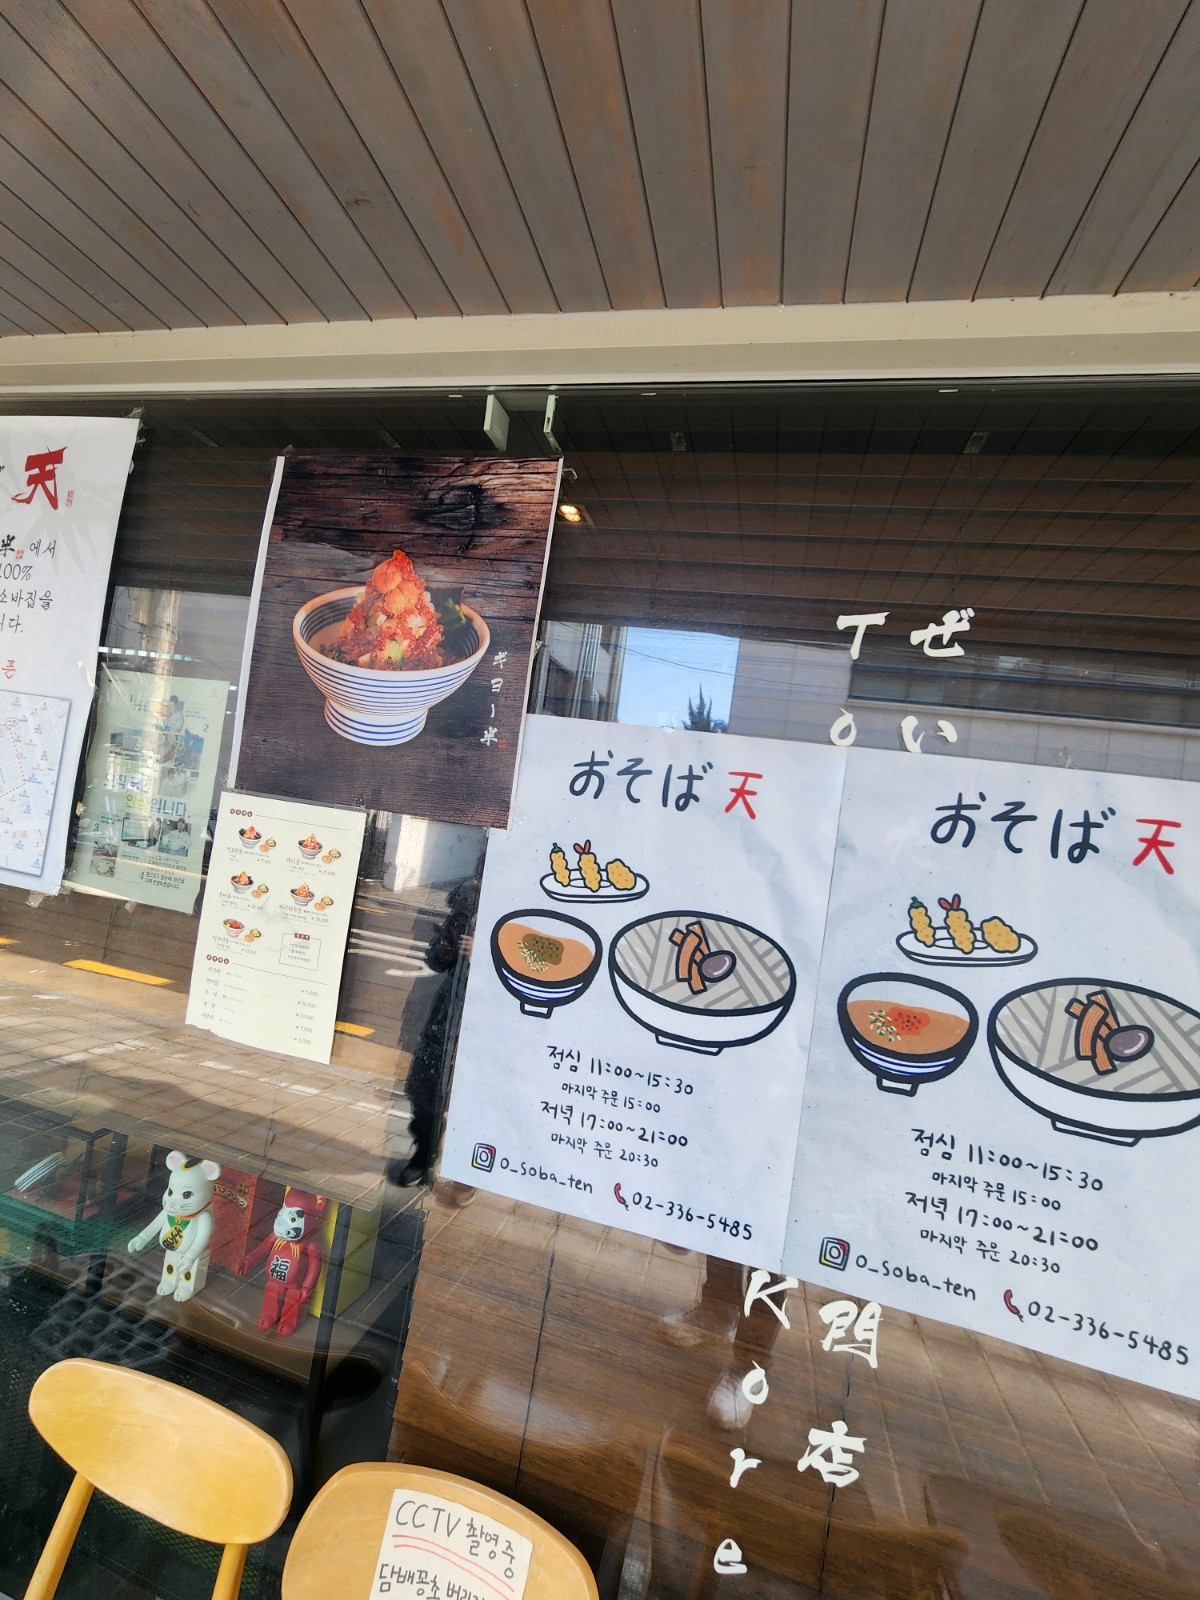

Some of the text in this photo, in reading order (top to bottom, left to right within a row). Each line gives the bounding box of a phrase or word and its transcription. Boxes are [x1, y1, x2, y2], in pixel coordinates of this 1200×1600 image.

[29, 539, 57, 559] 에서
[546, 1045, 581, 1073] 점심
[540, 1100, 574, 1126] 저녁
[561, 1082, 661, 1114] 마지막 주문 15:00
[550, 1133, 659, 1168] 마지막 주문 20:30
[910, 1128, 956, 1161] 점심
[904, 1191, 948, 1221] 저녁
[931, 1171, 1061, 1211] 마지막 주문 15:00
[632, 1191, 753, 1241] 02-336-5485
[919, 1229, 1061, 1274] 마지막 주문 20:30
[269, 1254, 291, 1283] 福
[1027, 1300, 1190, 1366] 02-336-5485
[395, 1500, 461, 1538] CCTV
